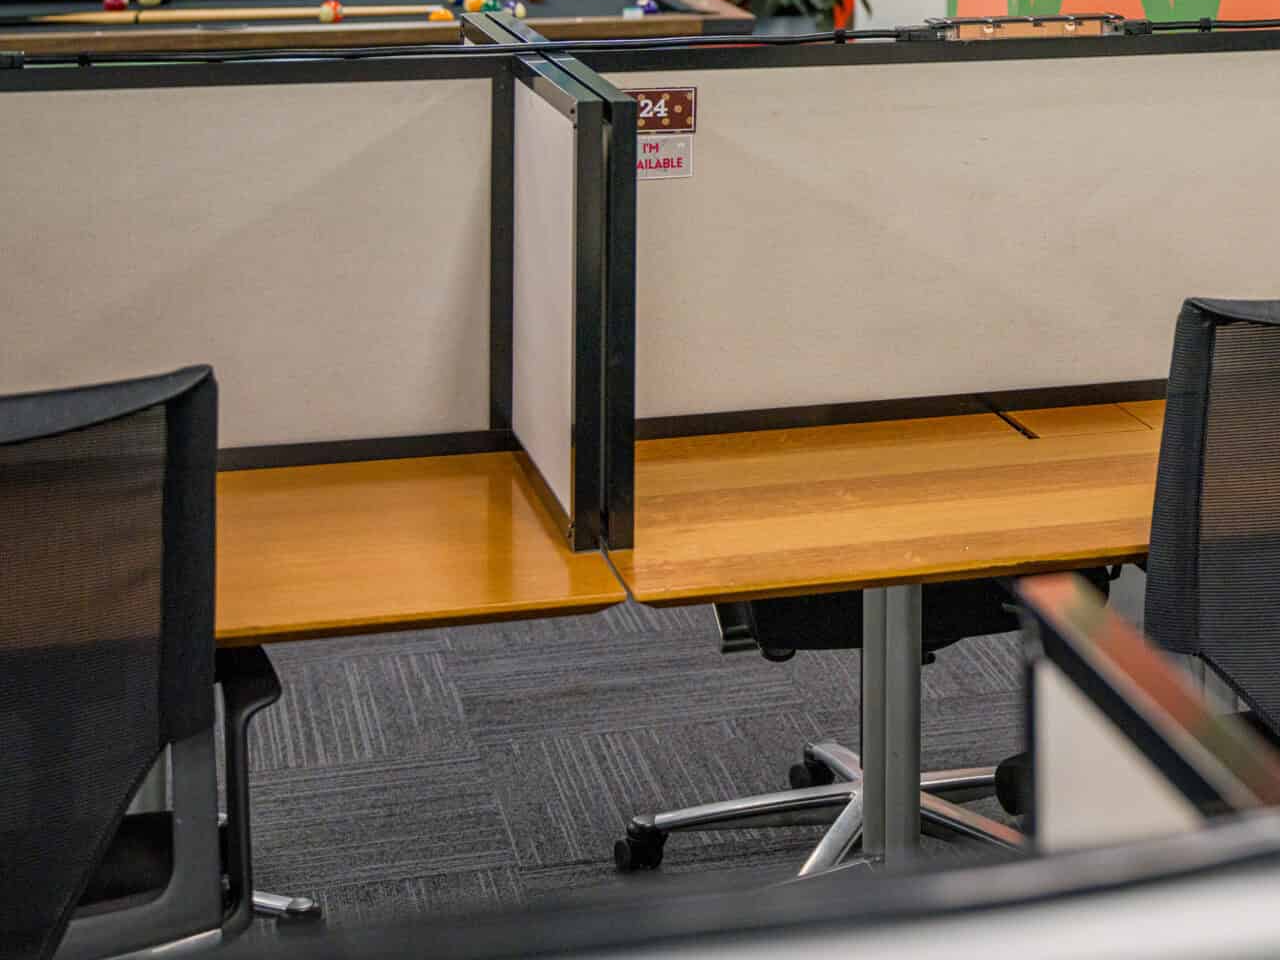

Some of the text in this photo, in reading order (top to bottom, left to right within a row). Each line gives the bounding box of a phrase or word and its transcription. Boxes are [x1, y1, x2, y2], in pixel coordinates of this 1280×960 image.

[639, 99, 668, 118] 24
[642, 143, 660, 154] I'M
[636, 157, 684, 170] AILABLE
